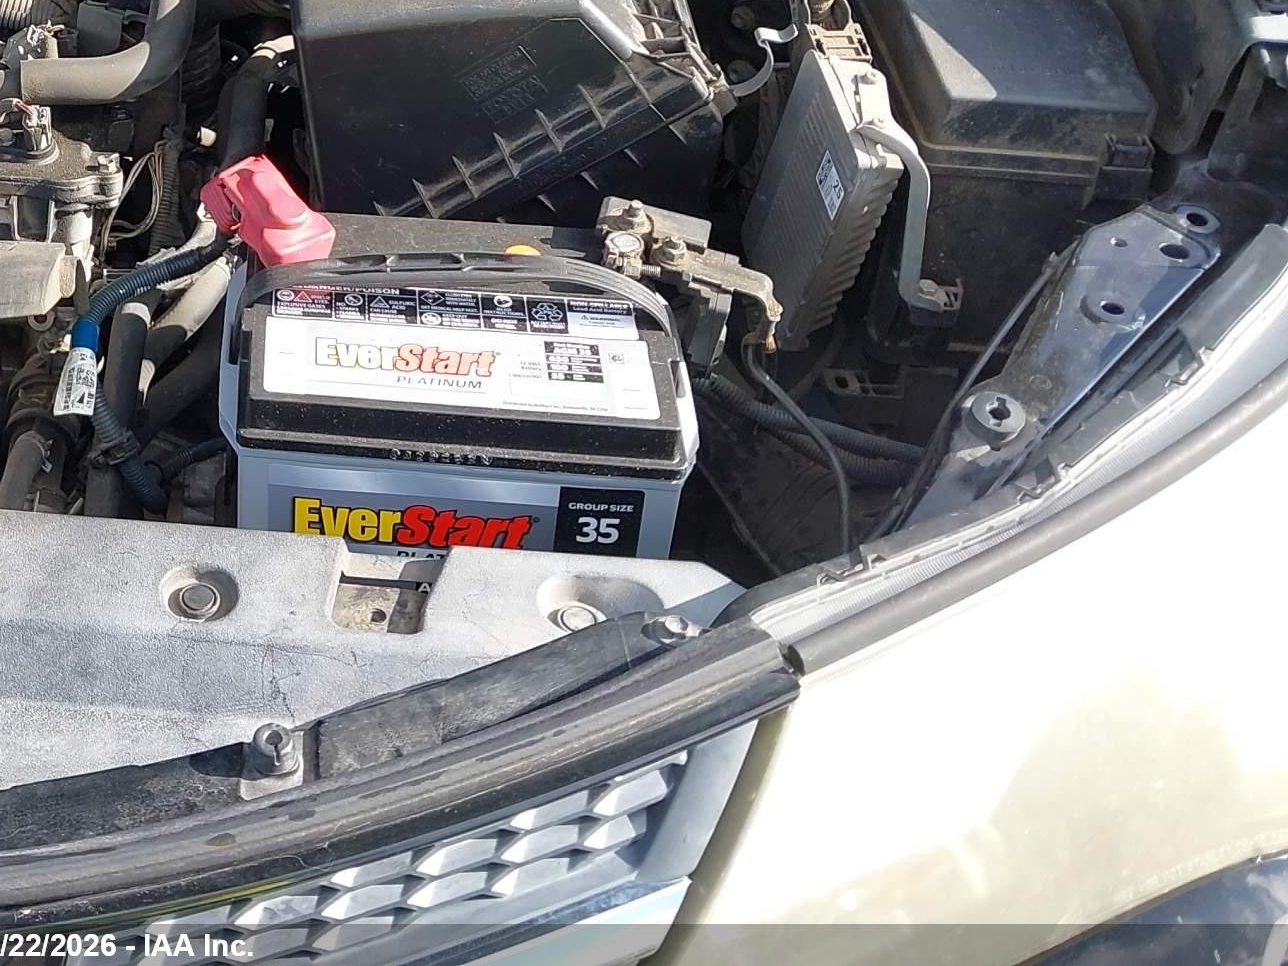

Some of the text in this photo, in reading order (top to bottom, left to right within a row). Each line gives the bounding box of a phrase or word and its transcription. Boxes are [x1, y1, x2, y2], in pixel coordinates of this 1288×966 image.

[315, 336, 496, 377] EverStart
[397, 375, 482, 389] PLATINUM
[568, 502, 634, 513] GROUP SIZE
[292, 496, 534, 549] EverStart
[575, 516, 620, 544] 35
